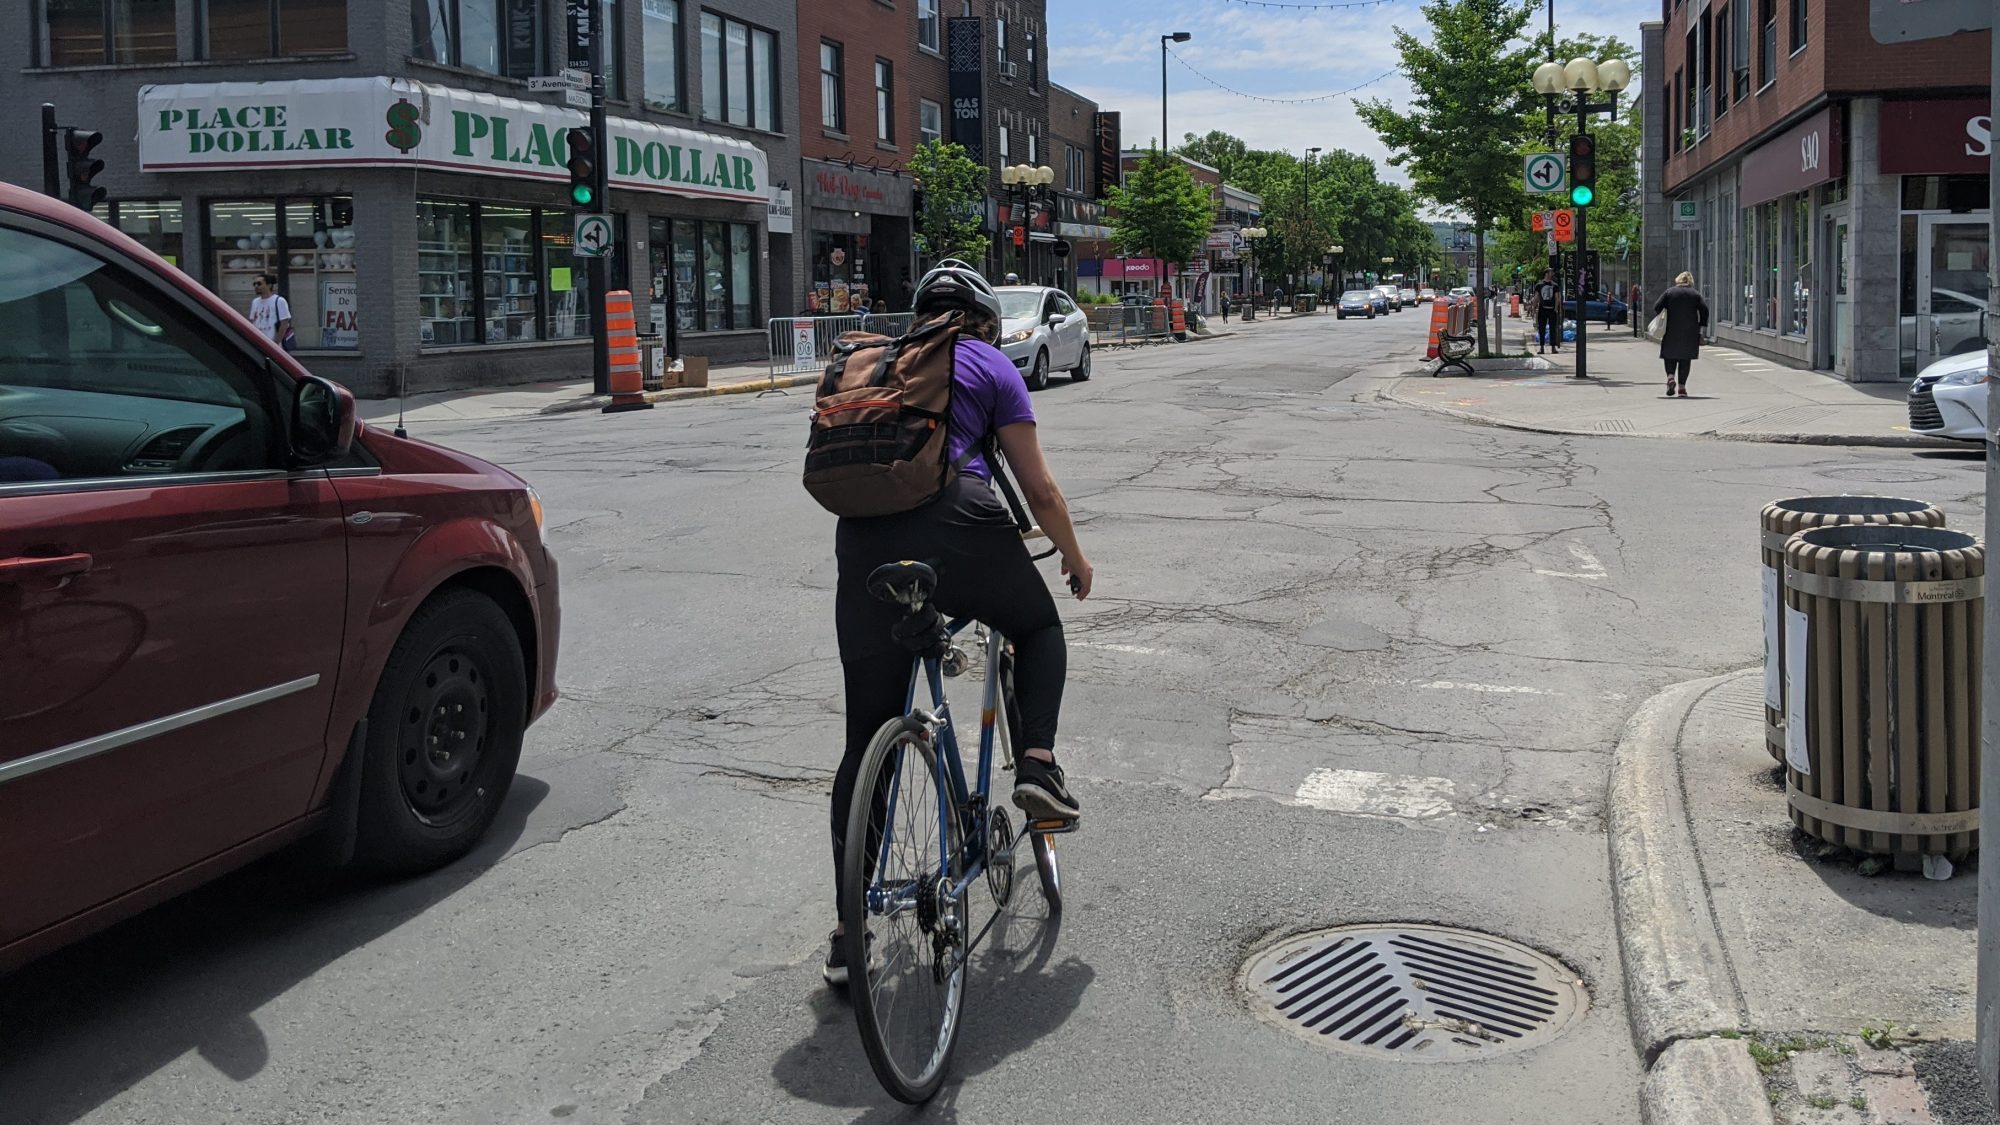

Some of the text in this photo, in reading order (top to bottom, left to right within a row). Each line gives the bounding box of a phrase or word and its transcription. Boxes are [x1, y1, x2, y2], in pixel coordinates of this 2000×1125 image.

[954, 97, 979, 109] GAS
[954, 108, 979, 119] TON
[158, 105, 287, 132] PLACE
[188, 127, 355, 154] DOLLAR
[451, 109, 756, 192] PLAC DOLLAR
[1801, 130, 1819, 173] SAQ
[326, 310, 359, 332] FAX
